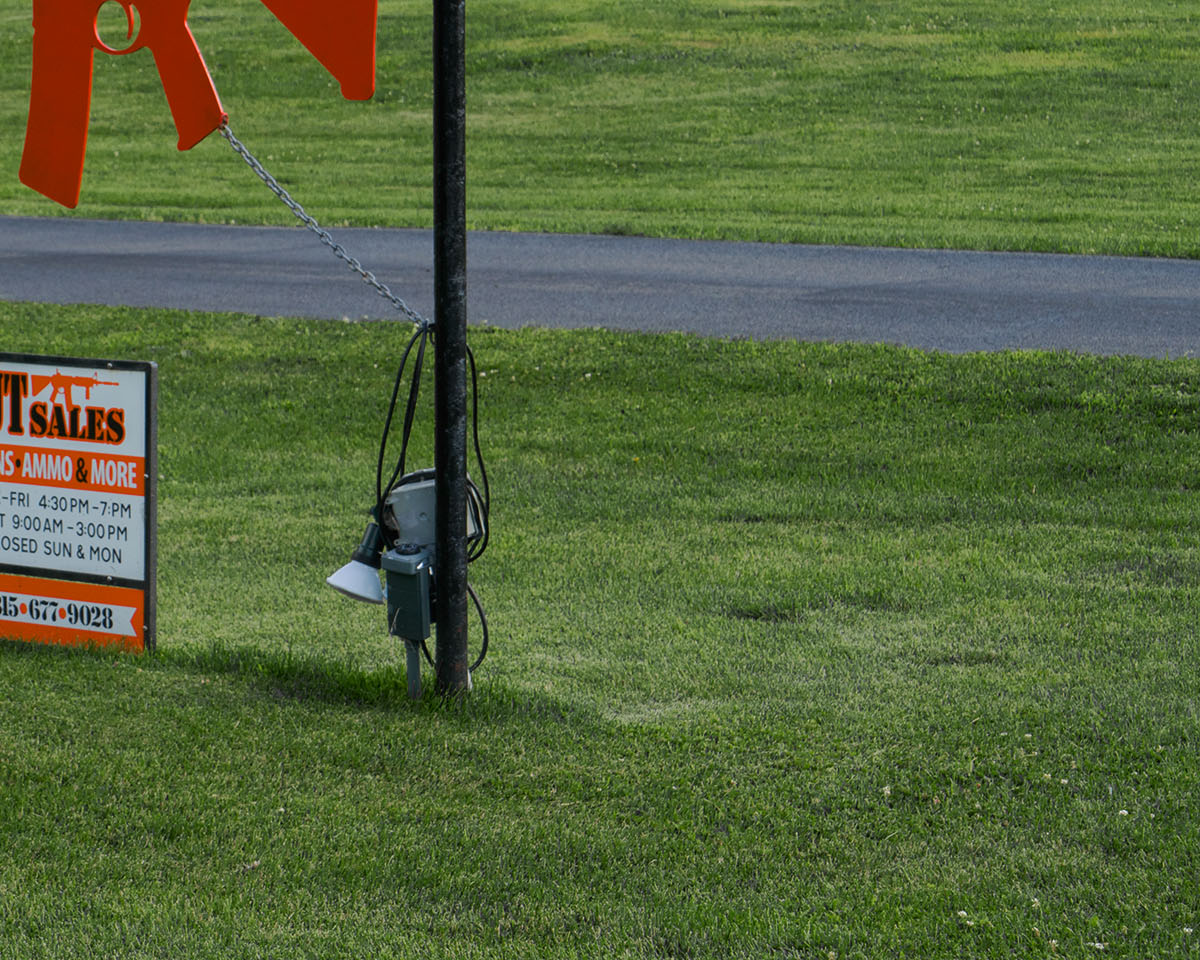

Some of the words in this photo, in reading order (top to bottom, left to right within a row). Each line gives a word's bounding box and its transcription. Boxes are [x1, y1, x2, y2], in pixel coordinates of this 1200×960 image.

[29, 401, 126, 446] SALES
[75, 457, 88, 483] &
[90, 458, 137, 489] MORE
[43, 540, 73, 558] SUN
[76, 544, 86, 560] &
[89, 545, 122, 564] MON
